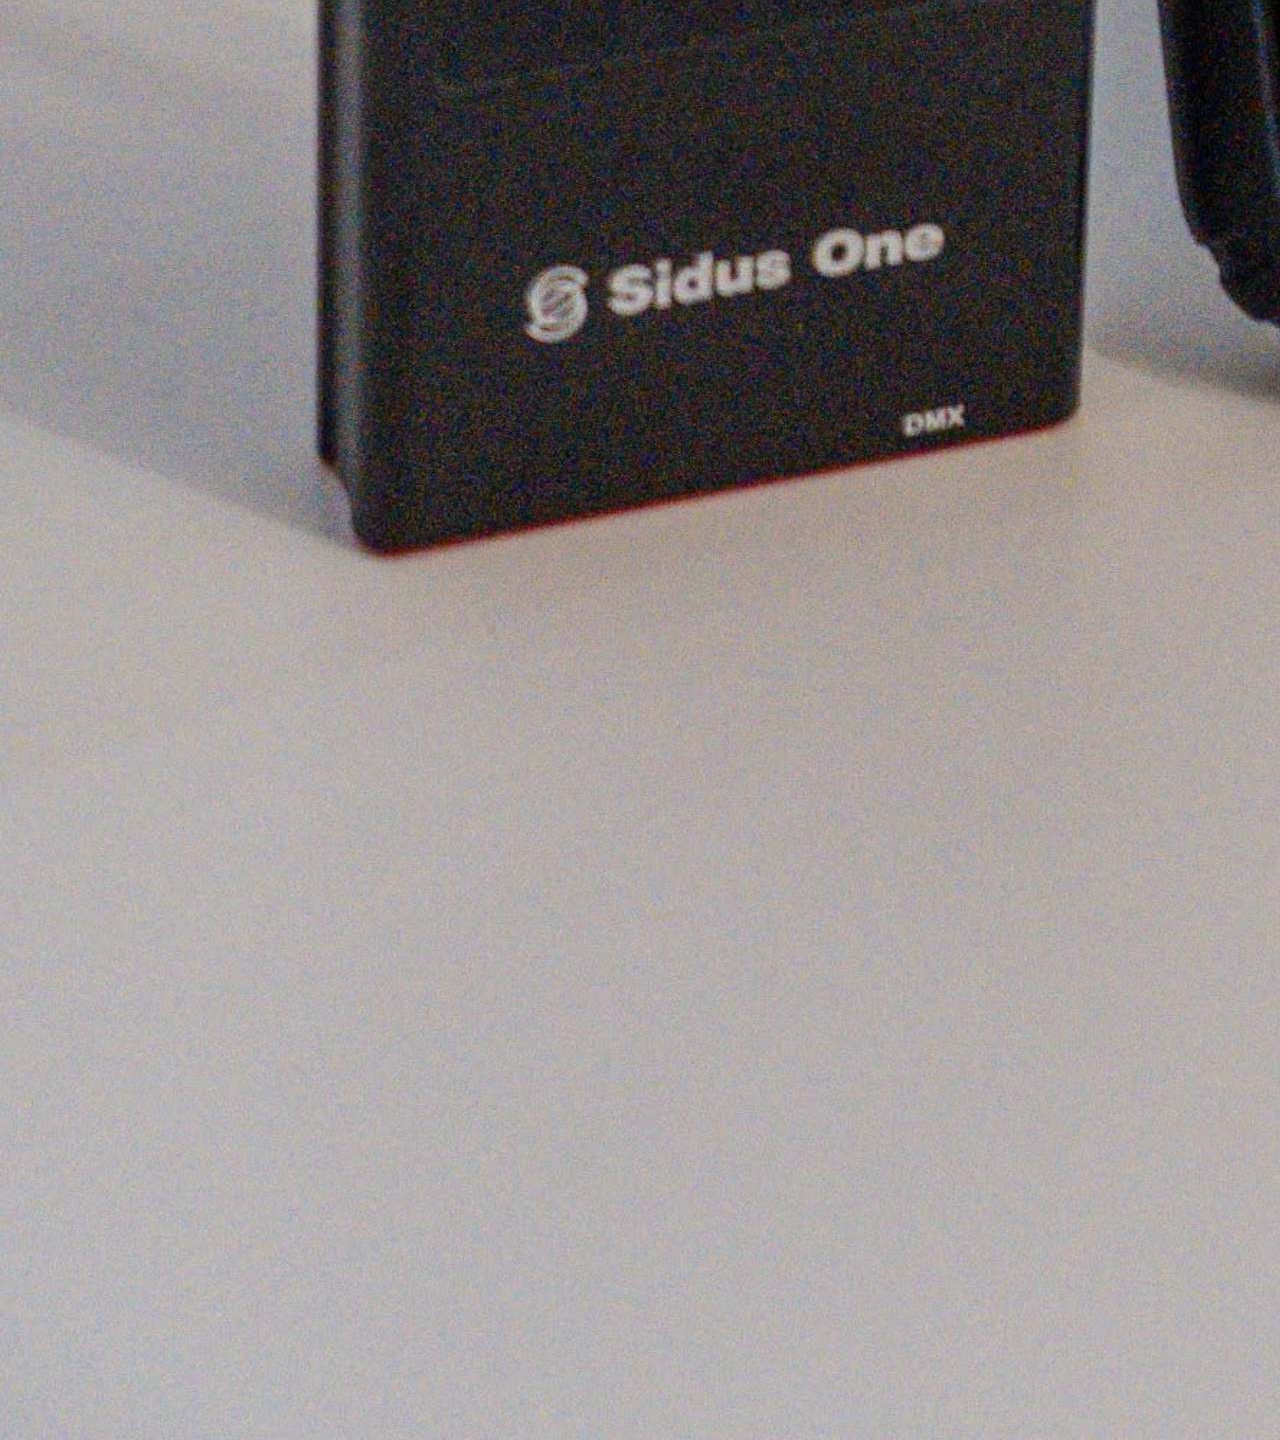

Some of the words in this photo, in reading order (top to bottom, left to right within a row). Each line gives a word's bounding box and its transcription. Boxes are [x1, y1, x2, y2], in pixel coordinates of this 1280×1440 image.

[607, 247, 791, 315] Sidus
[813, 223, 944, 276] One
[904, 405, 964, 436] DMX
